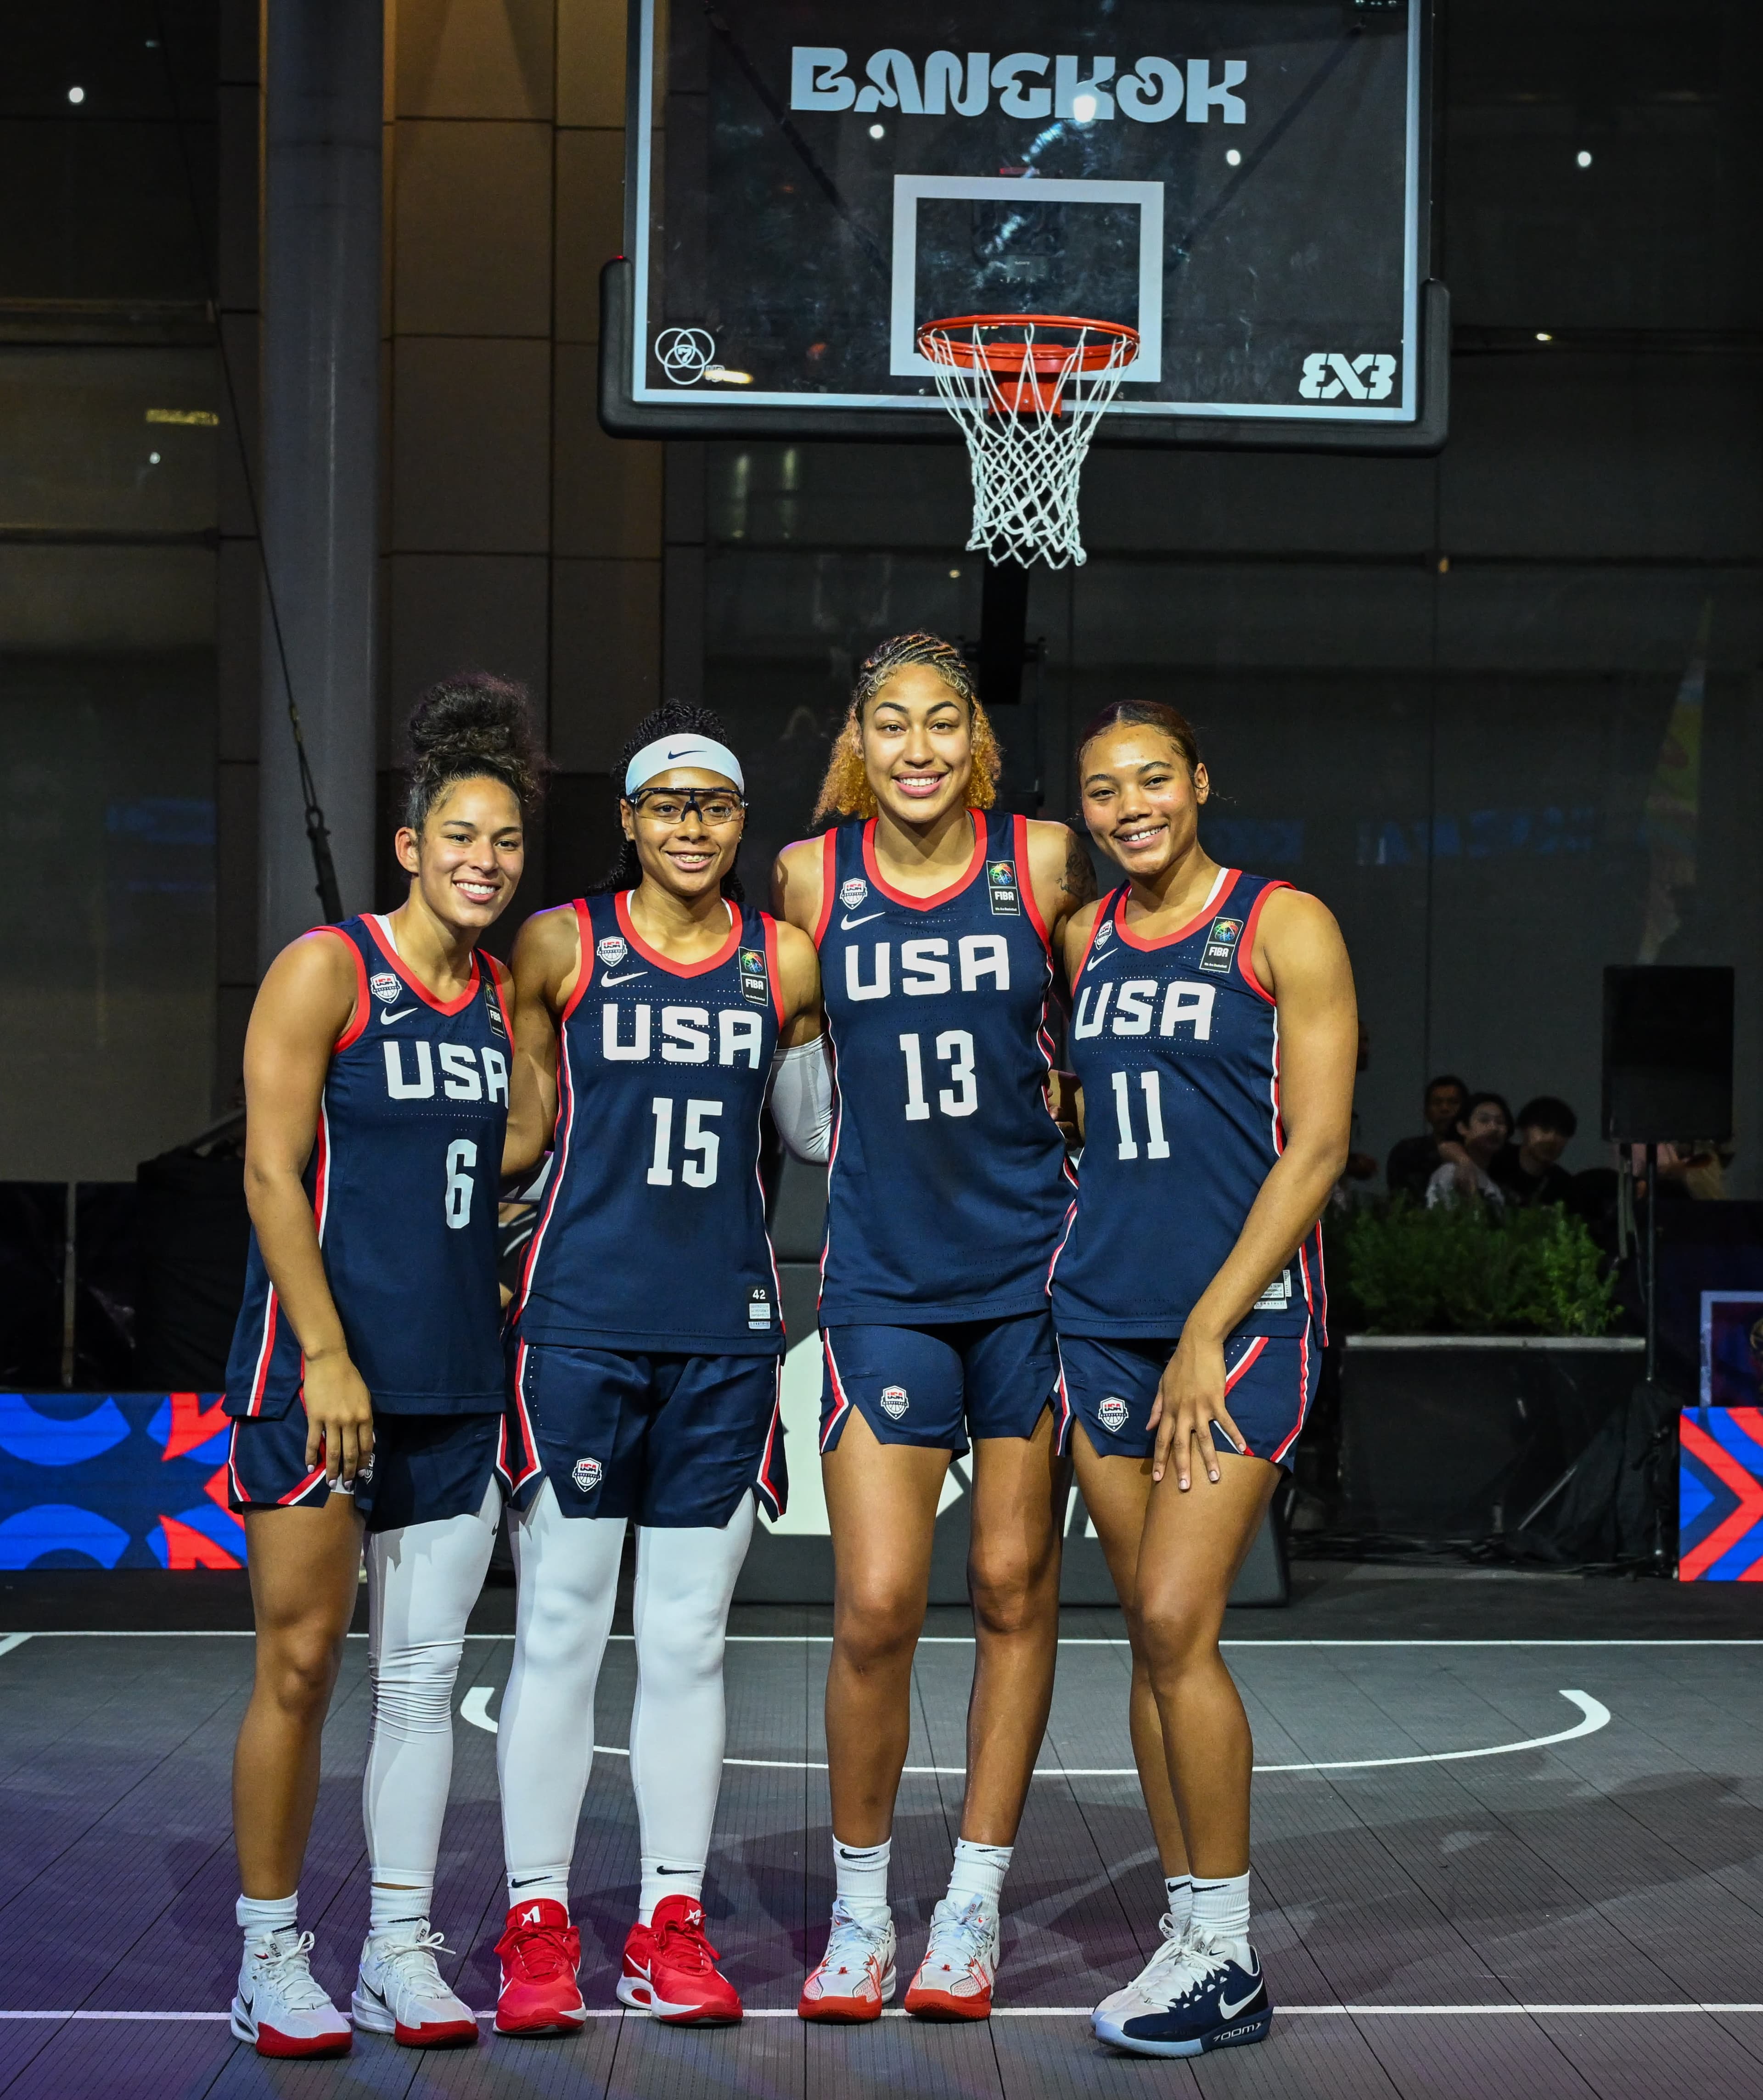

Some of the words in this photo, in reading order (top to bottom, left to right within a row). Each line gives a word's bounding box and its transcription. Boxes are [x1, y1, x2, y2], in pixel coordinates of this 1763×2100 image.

[791, 46, 1246, 124] BANGKOK
[994, 891, 1014, 901] FIBA
[745, 978, 764, 990] FIBA
[845, 934, 1010, 1001] USA
[1208, 946, 1229, 957] FIBA
[602, 1003, 763, 1070] USA
[1075, 979, 1216, 1040] USA
[382, 1040, 509, 1110] USA
[899, 1029, 978, 1121] 13
[646, 1097, 724, 1189] 15
[1112, 1071, 1170, 1160] 11
[444, 1139, 478, 1229] 6
[752, 1289, 766, 1300] 42
